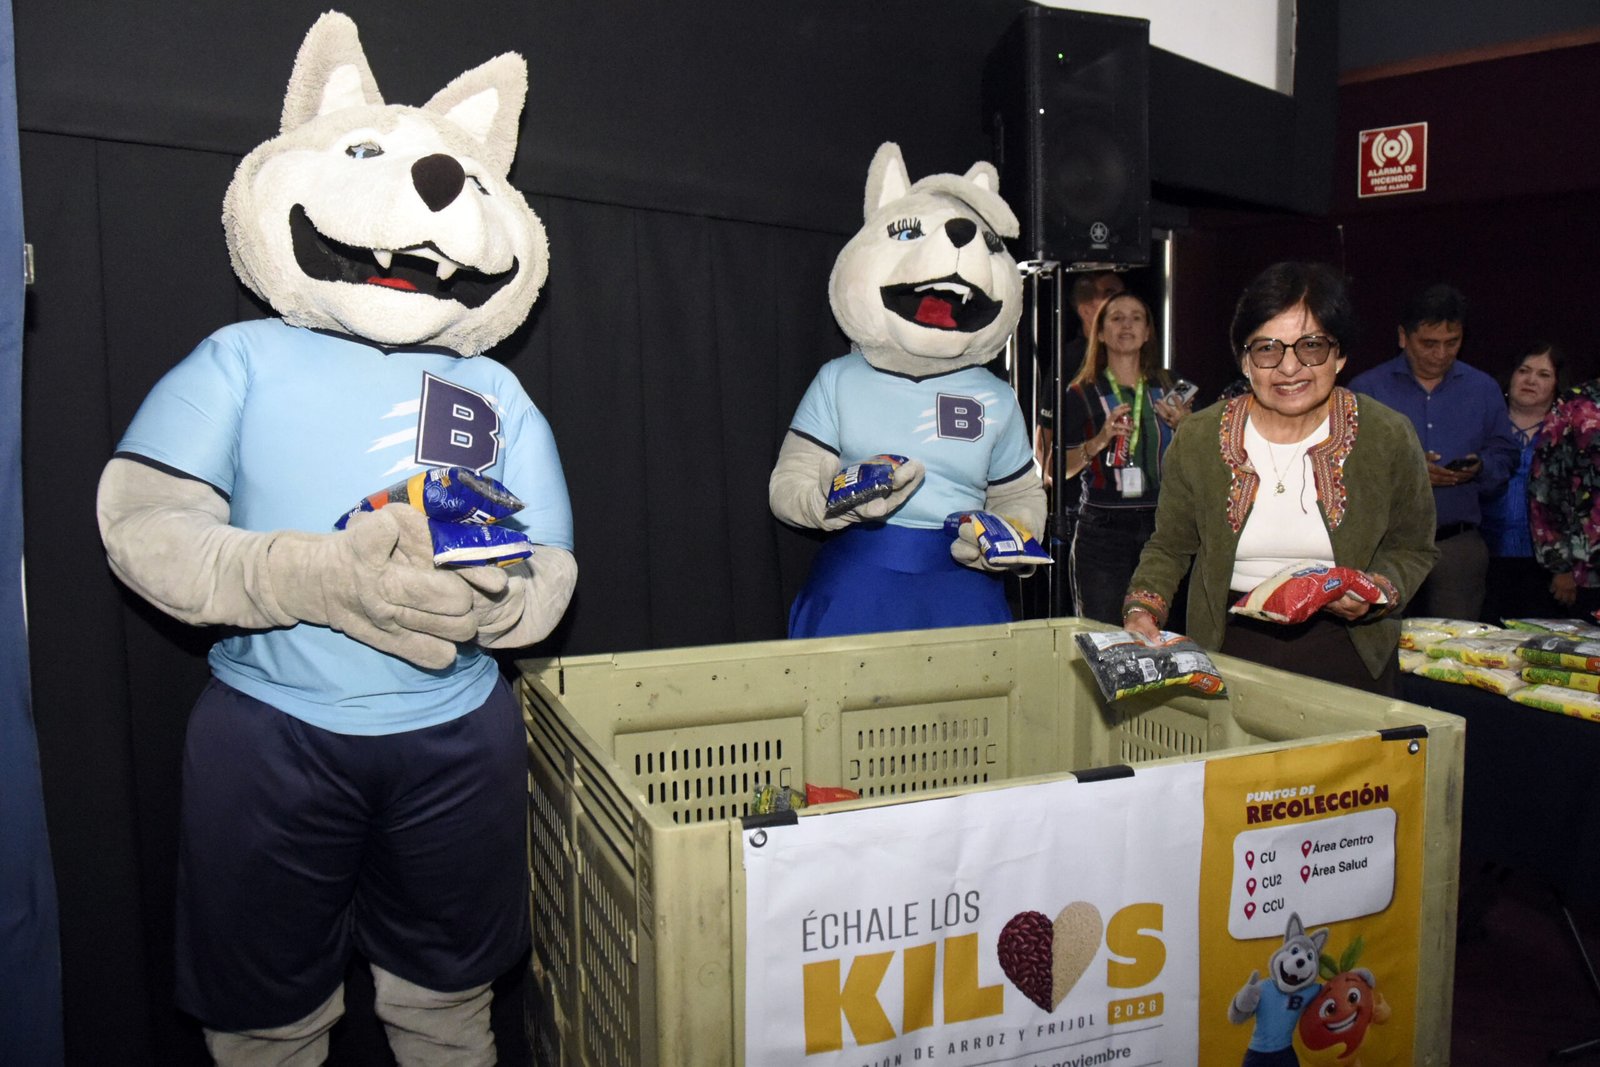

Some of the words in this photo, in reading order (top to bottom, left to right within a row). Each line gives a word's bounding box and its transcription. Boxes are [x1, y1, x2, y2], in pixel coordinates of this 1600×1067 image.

[1367, 166, 1403, 177] ALARMA
[1404, 164, 1417, 173] DE
[1371, 174, 1413, 185] INCENDIO
[415, 370, 499, 476] B
[936, 392, 985, 442] B
[1246, 787, 1297, 803] PUNTOS
[1299, 785, 1316, 796] DE
[1246, 783, 1389, 824] RECOLECCIÓN
[1312, 840, 1337, 854] Área
[1339, 835, 1374, 849] Centro
[1260, 851, 1276, 864] CU
[1311, 863, 1336, 877] Área
[1338, 857, 1368, 873] Salud
[1262, 874, 1282, 889] CU2
[1262, 898, 1285, 914] CCU
[802, 902, 920, 953] ÉCHALE
[930, 890, 981, 933] LOS
[914, 1046, 935, 1060] DE
[948, 1032, 1005, 1055] ARROZ
[1018, 1029, 1025, 1041] Y
[1037, 1014, 1095, 1037] FRIJOL
